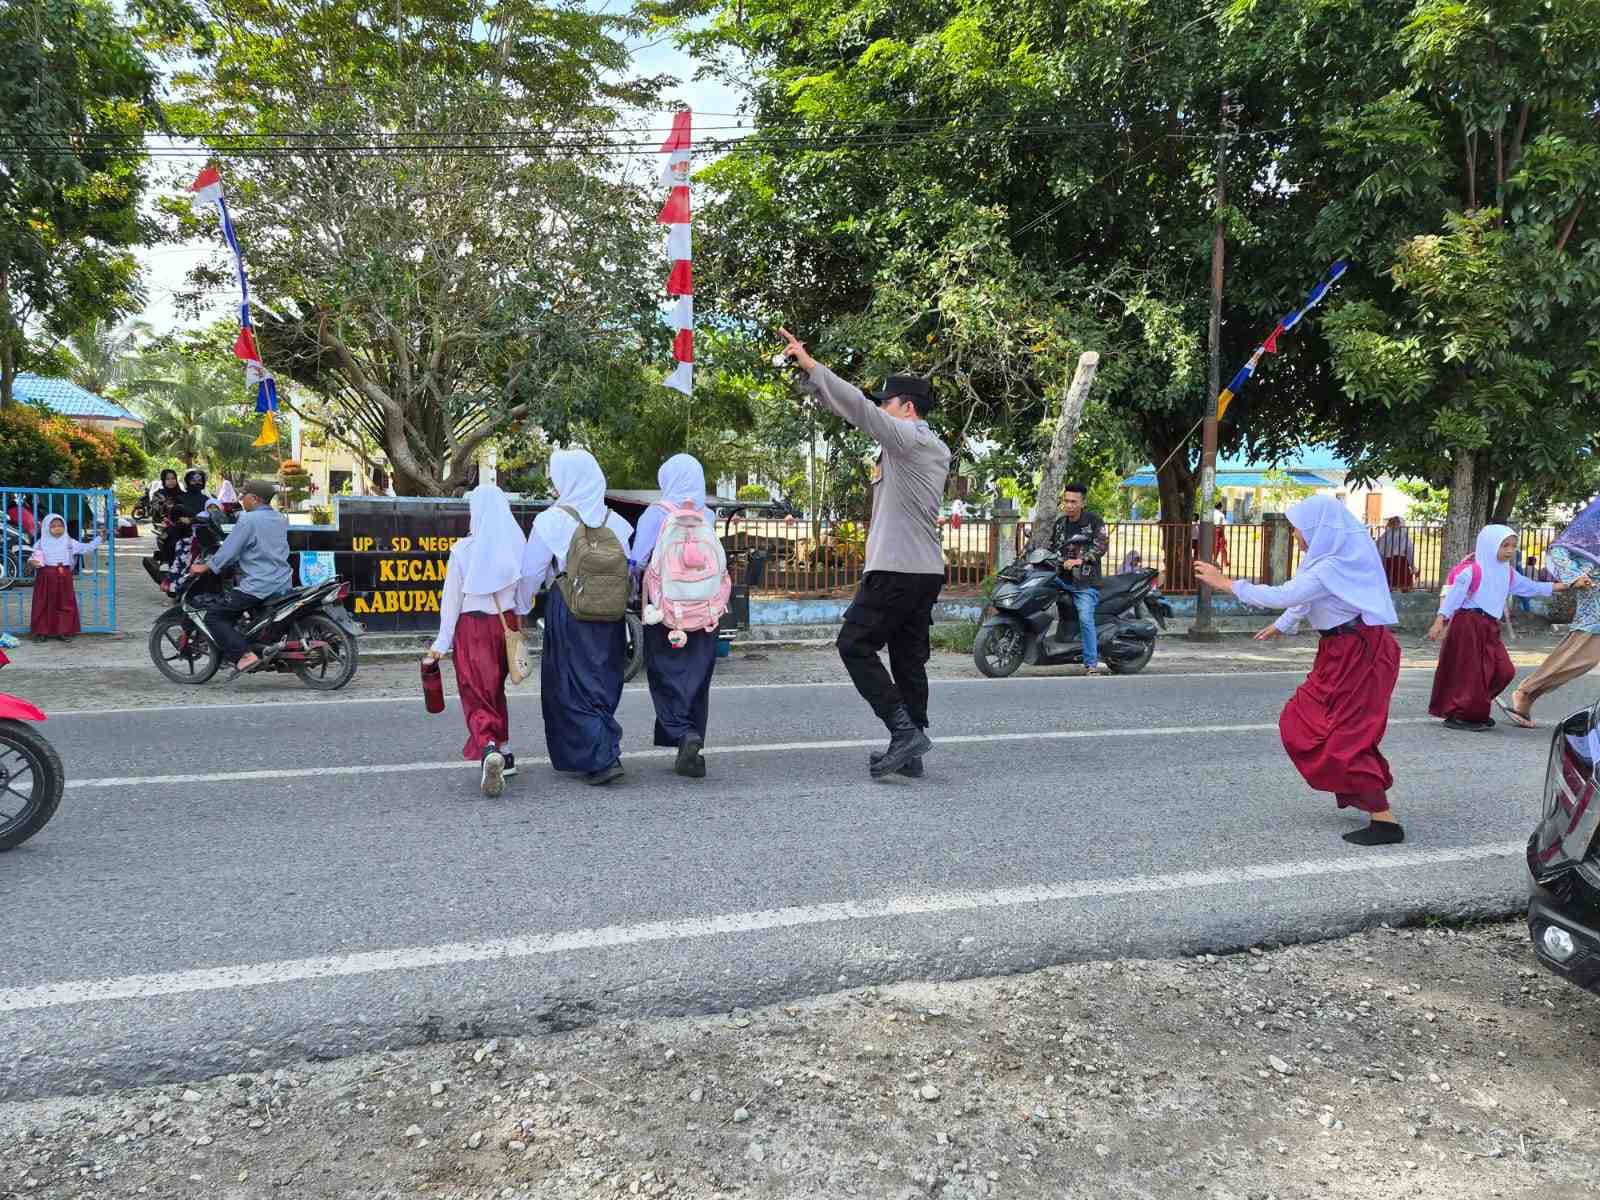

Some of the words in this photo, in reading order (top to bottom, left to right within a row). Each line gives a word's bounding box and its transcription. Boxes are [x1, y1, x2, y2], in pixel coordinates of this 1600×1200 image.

[391, 537, 412, 552] SD
[418, 537, 459, 552] NEGE
[354, 590, 443, 613] KABUPA
